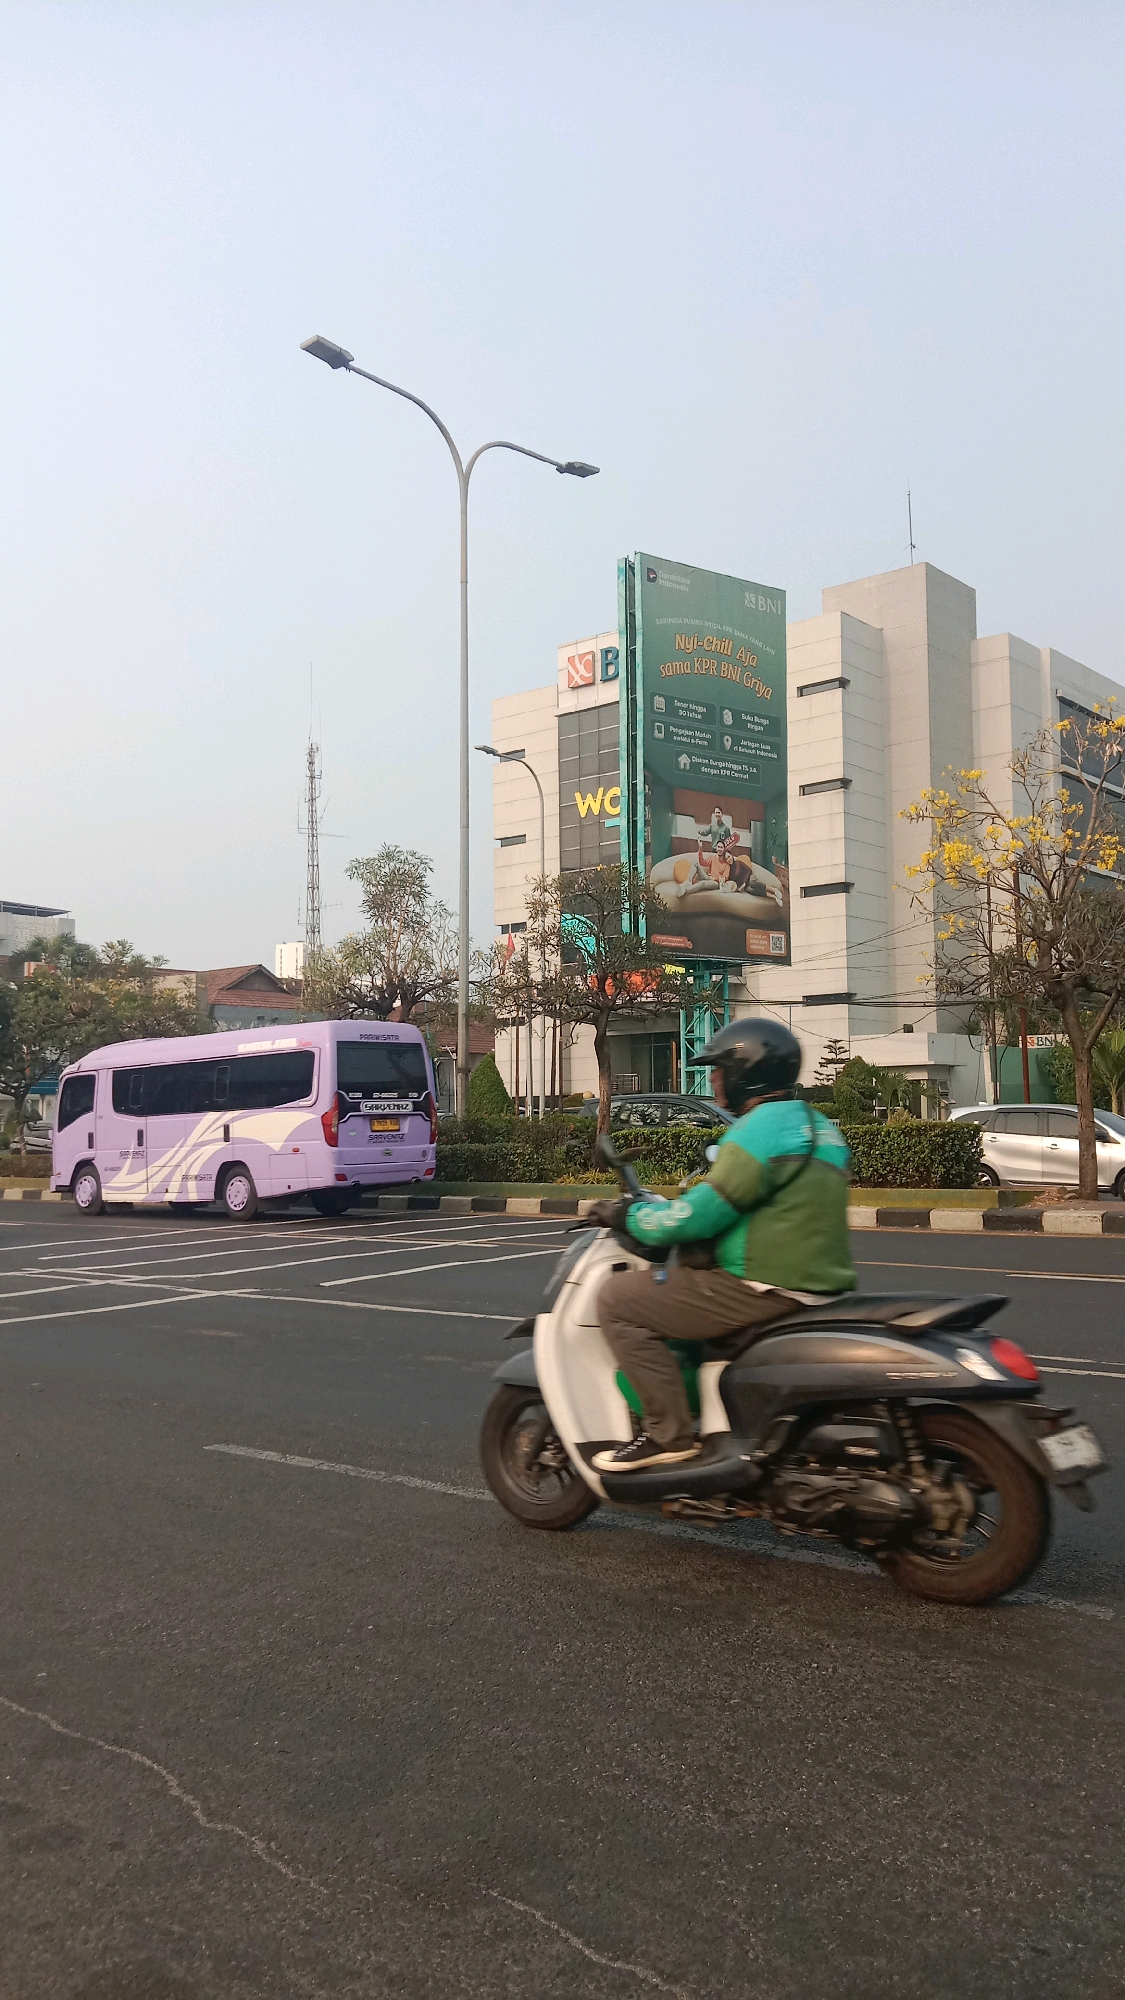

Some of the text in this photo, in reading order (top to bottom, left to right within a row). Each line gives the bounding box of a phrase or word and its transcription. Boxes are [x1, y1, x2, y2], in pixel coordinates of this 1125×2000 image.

[757, 595, 781, 615] BNI
[722, 625, 733, 634] KPR
[675, 632, 758, 668] Nyi-Chill Aja
[660, 657, 772, 700] sama KPR BNI Griya
[674, 700, 707, 713] Tenor hingga
[687, 711, 702, 719] Tahun
[741, 713, 770, 726] Suku Bunga
[741, 739, 760, 748] Jaringan
[756, 750, 778, 759] Indonesia
[701, 766, 720, 775] dengan
[725, 761, 742, 771] hingga
[364, 1103, 409, 1111] SARVENAZ
